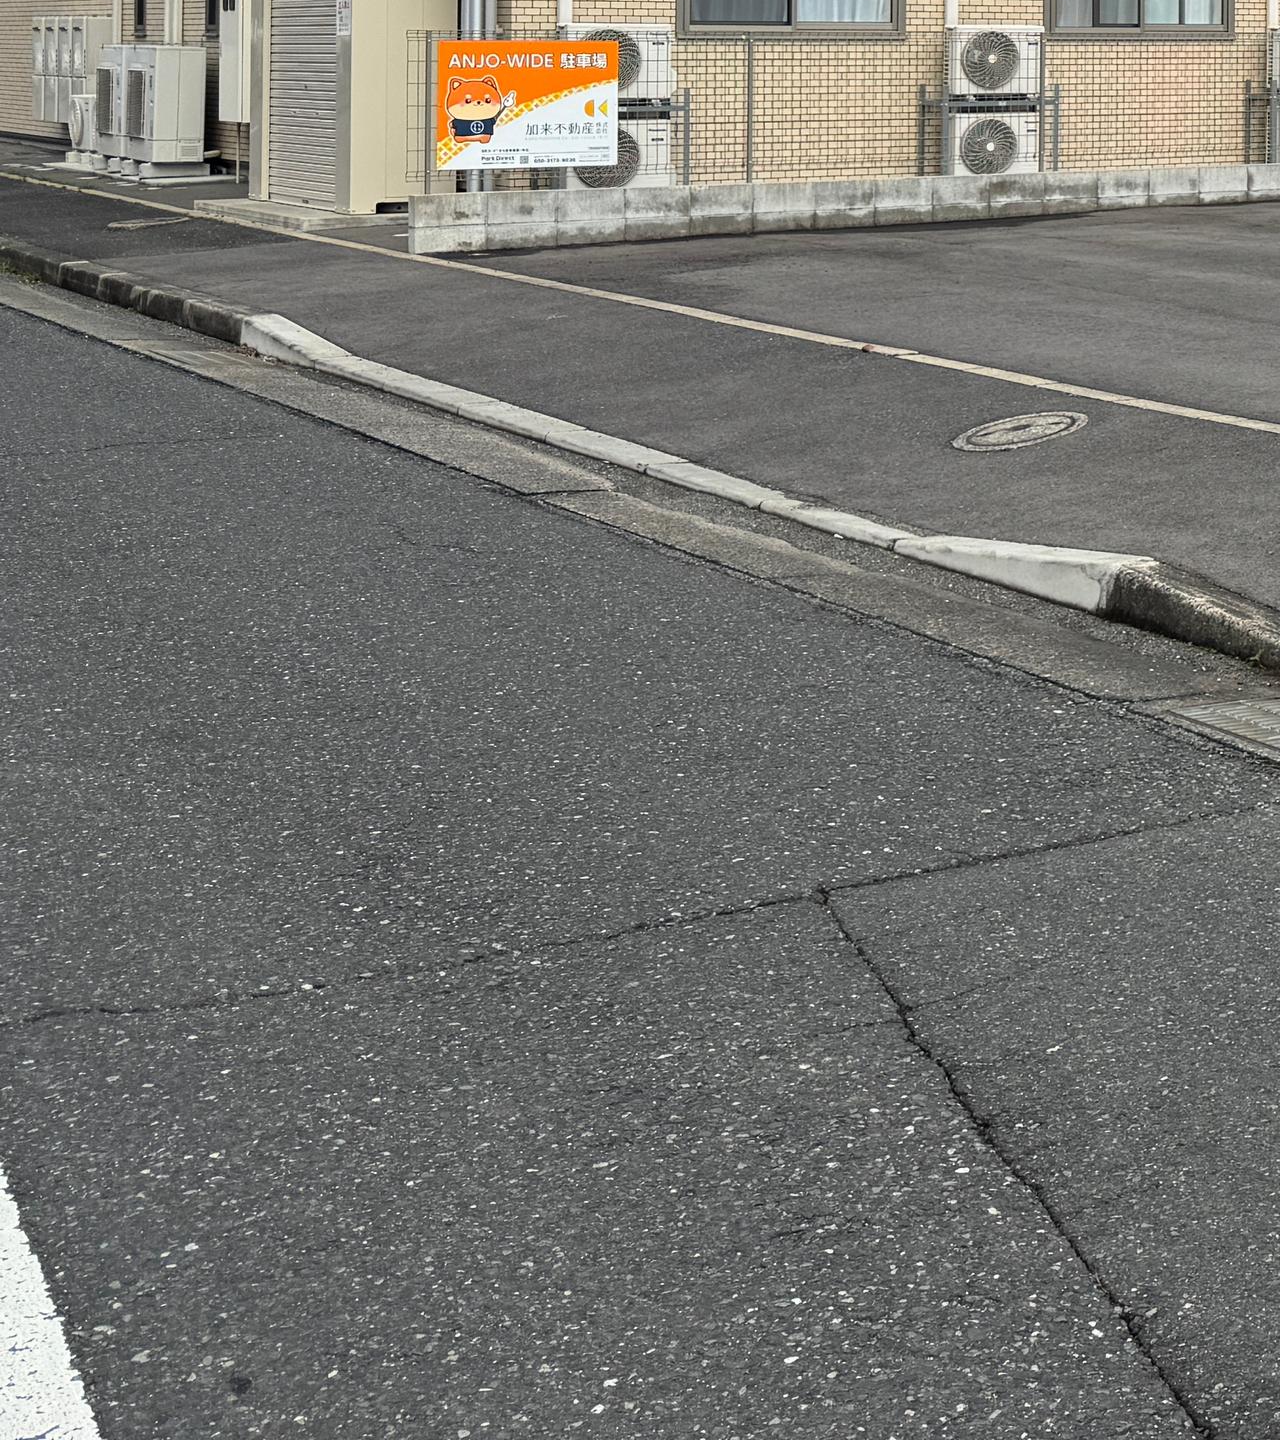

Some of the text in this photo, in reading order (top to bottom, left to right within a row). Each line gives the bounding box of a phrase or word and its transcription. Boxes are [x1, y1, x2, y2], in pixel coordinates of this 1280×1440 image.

[449, 53, 607, 69] ANJO-WIDE 駐車場
[525, 122, 594, 136] 加来不動産
